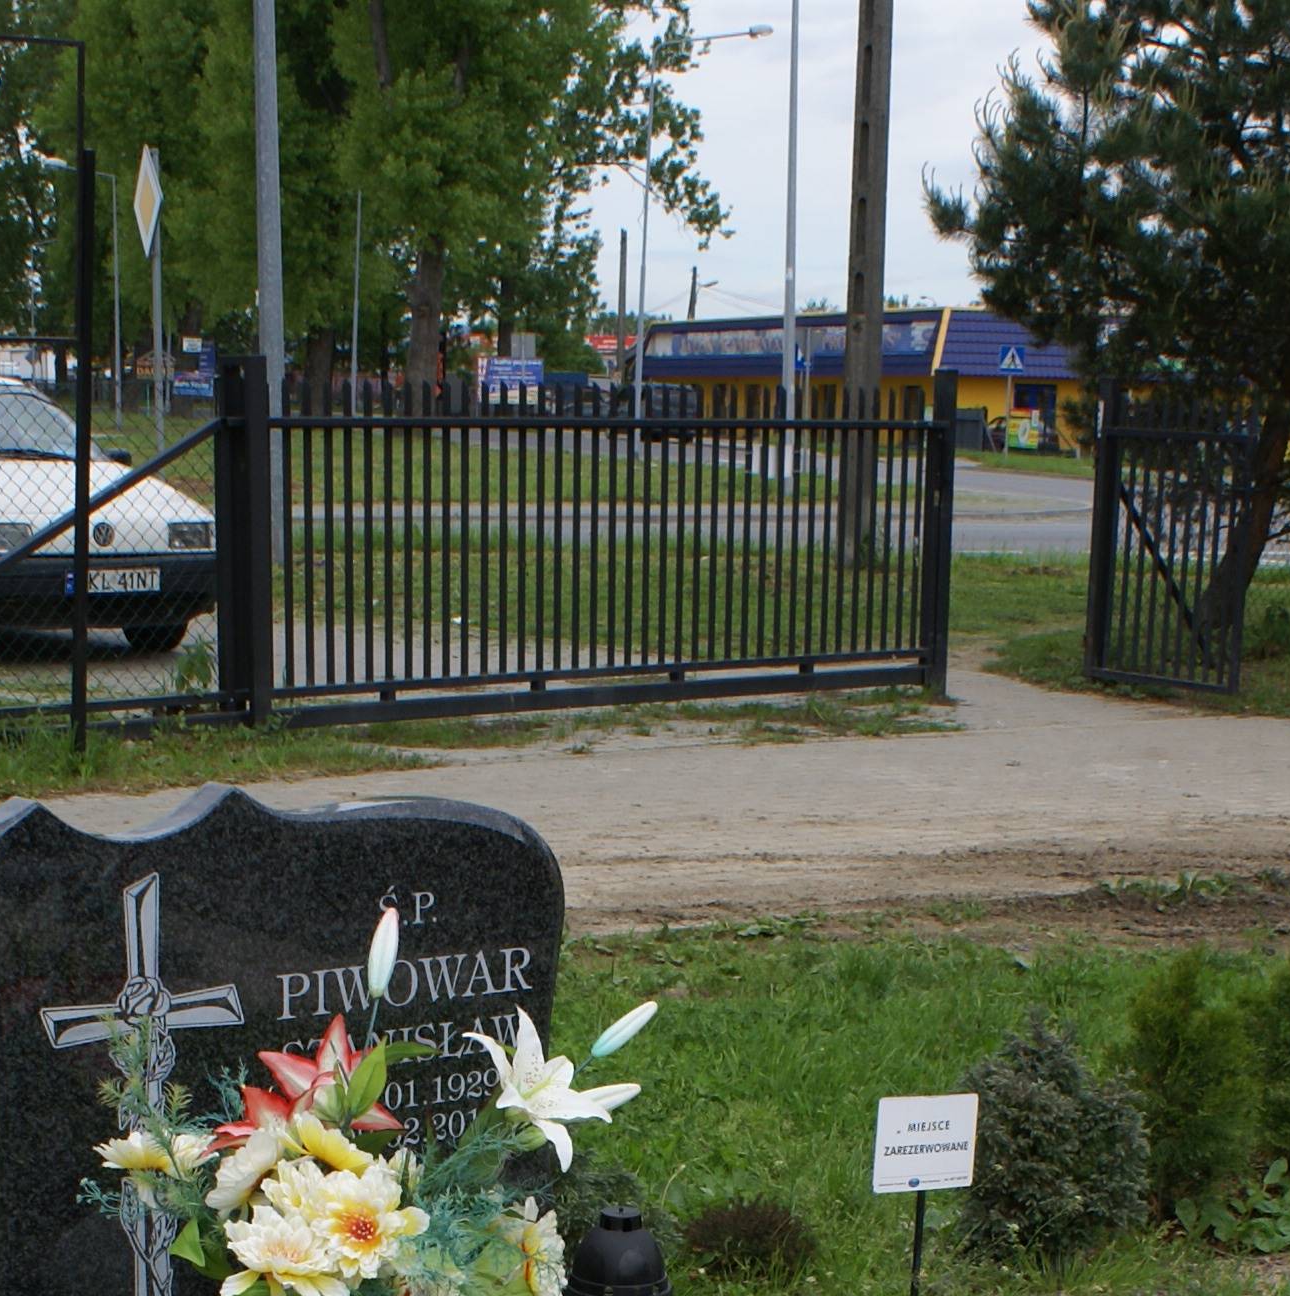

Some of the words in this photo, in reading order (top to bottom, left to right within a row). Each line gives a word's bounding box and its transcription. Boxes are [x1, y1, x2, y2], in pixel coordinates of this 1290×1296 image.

[276, 947, 533, 1021] PIWOWAR
[908, 1120, 950, 1132] MIEJSCE
[884, 1141, 969, 1156] ZAREZERWOWANE
